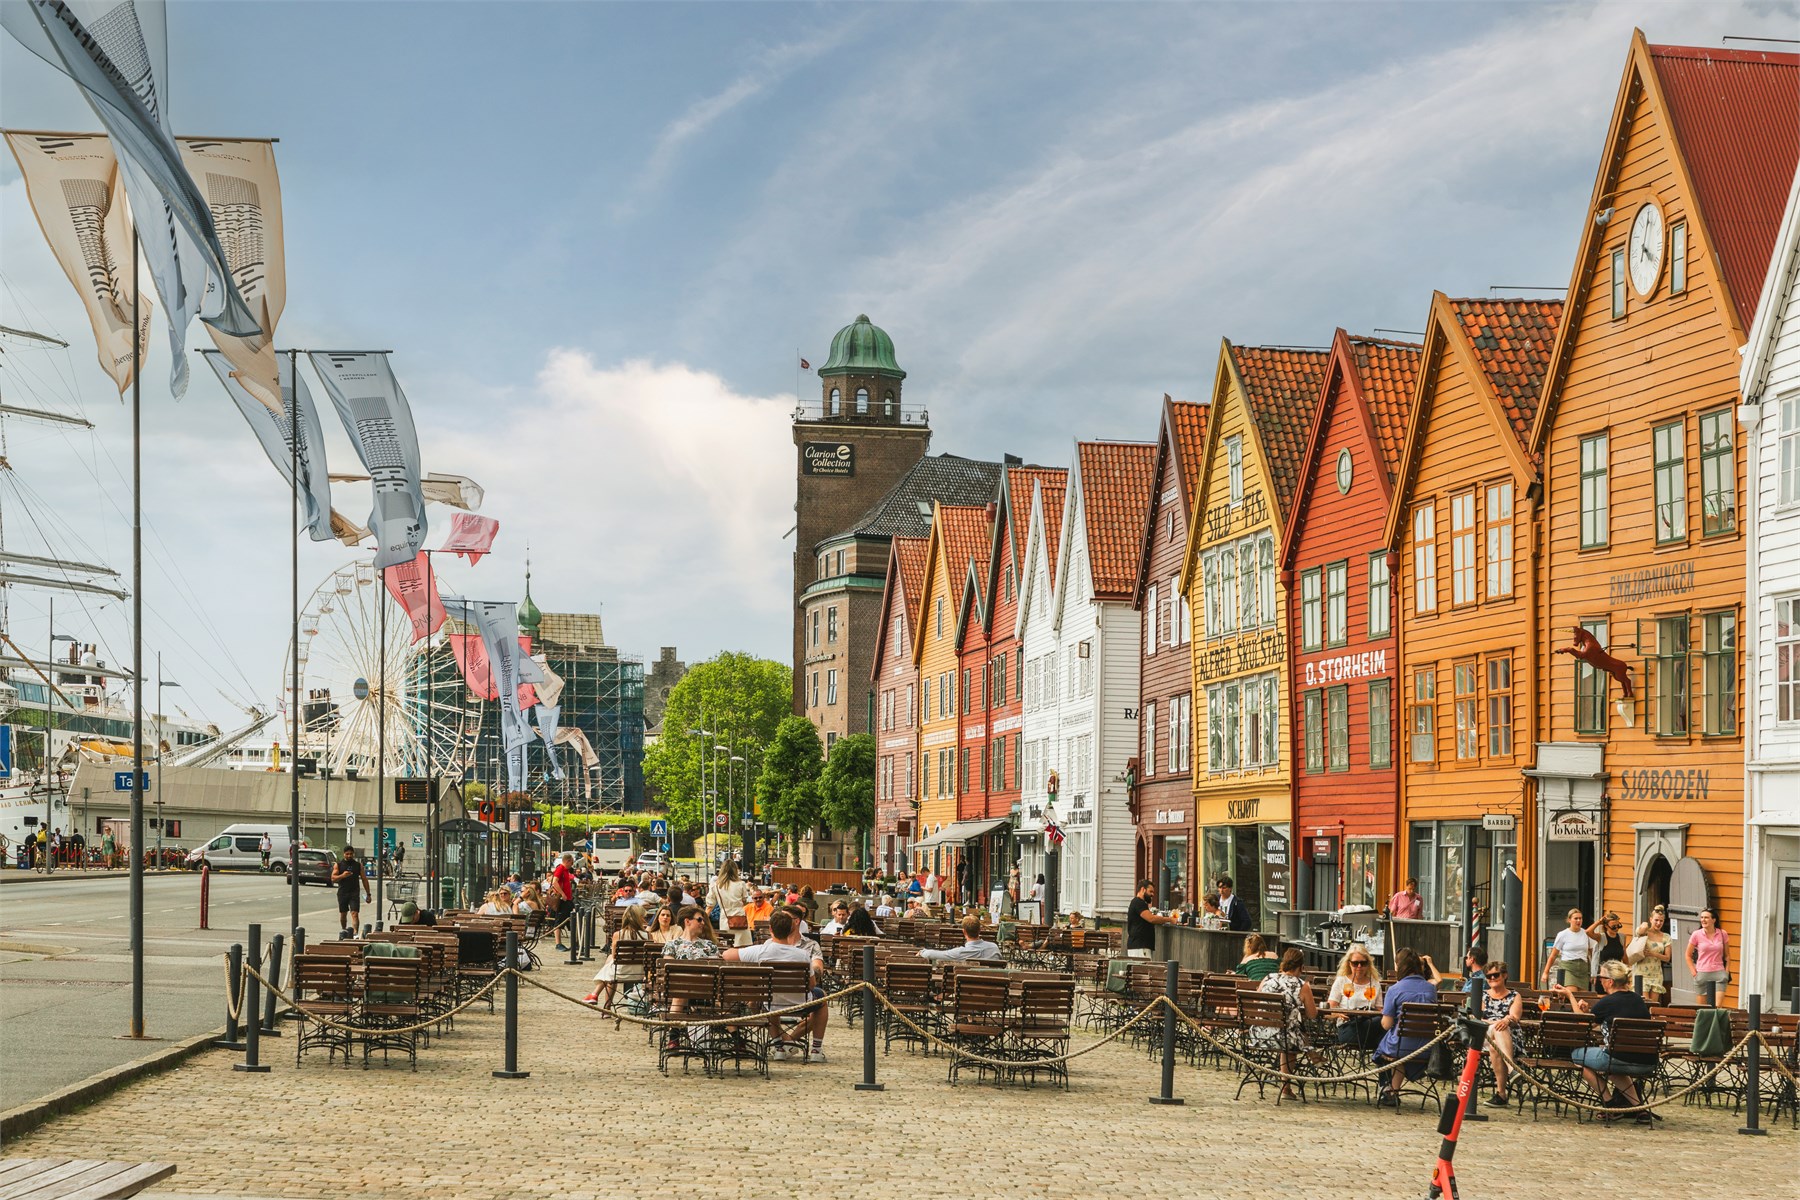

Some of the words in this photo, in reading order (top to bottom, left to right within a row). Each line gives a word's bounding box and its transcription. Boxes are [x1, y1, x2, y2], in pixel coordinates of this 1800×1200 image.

[806, 446, 836, 458] Clarion
[812, 458, 851, 468] Collection
[390, 540, 418, 551] equinor
[1610, 561, 1694, 605] ENHJØRNINGEN
[1200, 646, 1232, 680] ALFRED
[1621, 770, 1709, 800] SJØBODEN
[1228, 798, 1260, 820] SCHJØTT
[1552, 824, 1563, 835] To
[1564, 824, 1596, 835] Kokker
[1268, 840, 1284, 850] OPPDAG
[1266, 854, 1286, 864] BRYGGEN
